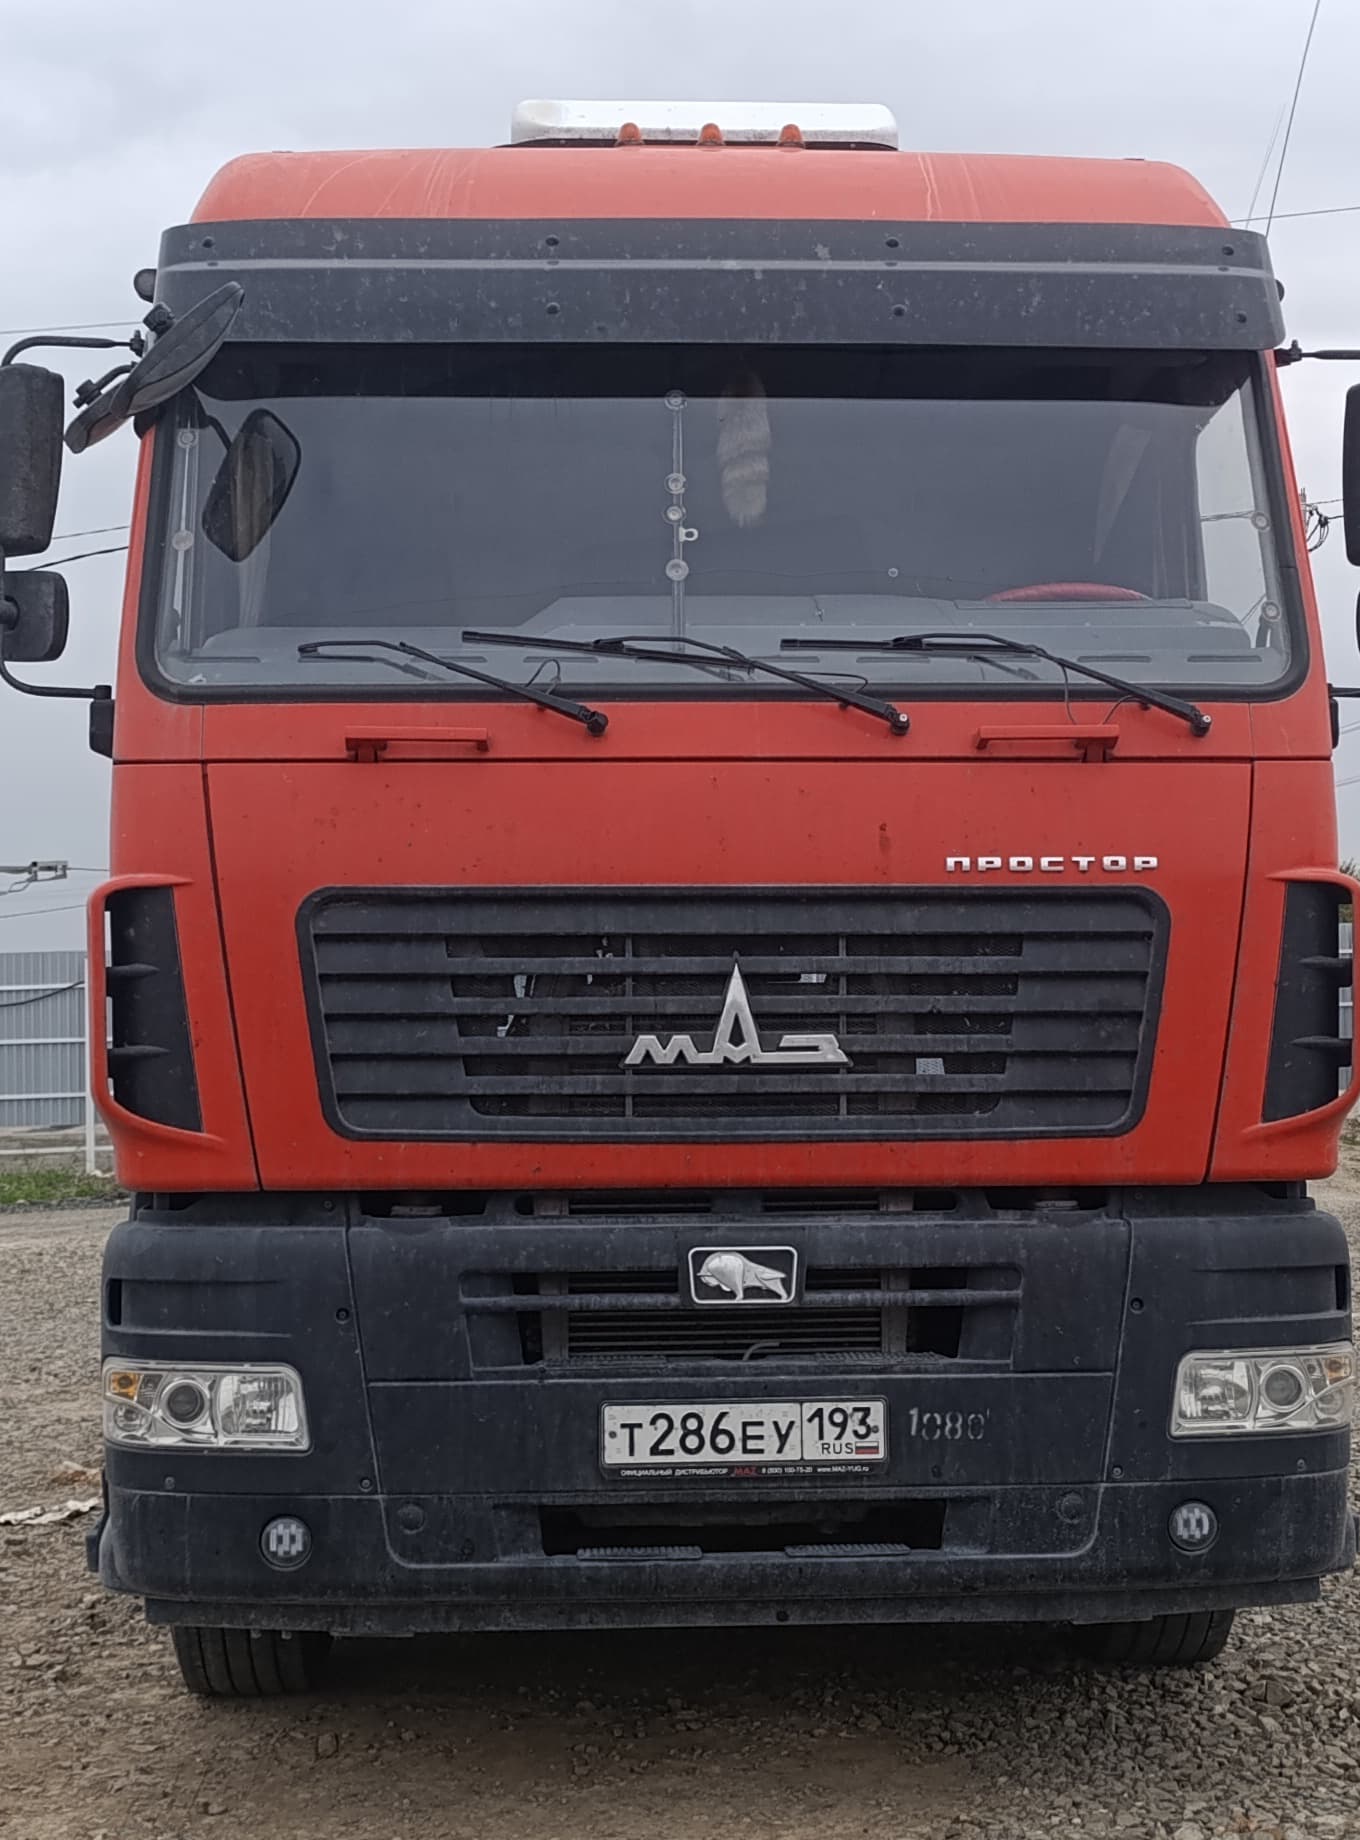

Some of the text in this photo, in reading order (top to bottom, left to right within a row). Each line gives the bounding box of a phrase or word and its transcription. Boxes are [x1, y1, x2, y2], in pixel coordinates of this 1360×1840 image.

[946, 856, 1158, 872] ПРОСТОР
[806, 1406, 872, 1441] 193
[821, 1442, 854, 1455] RUS
